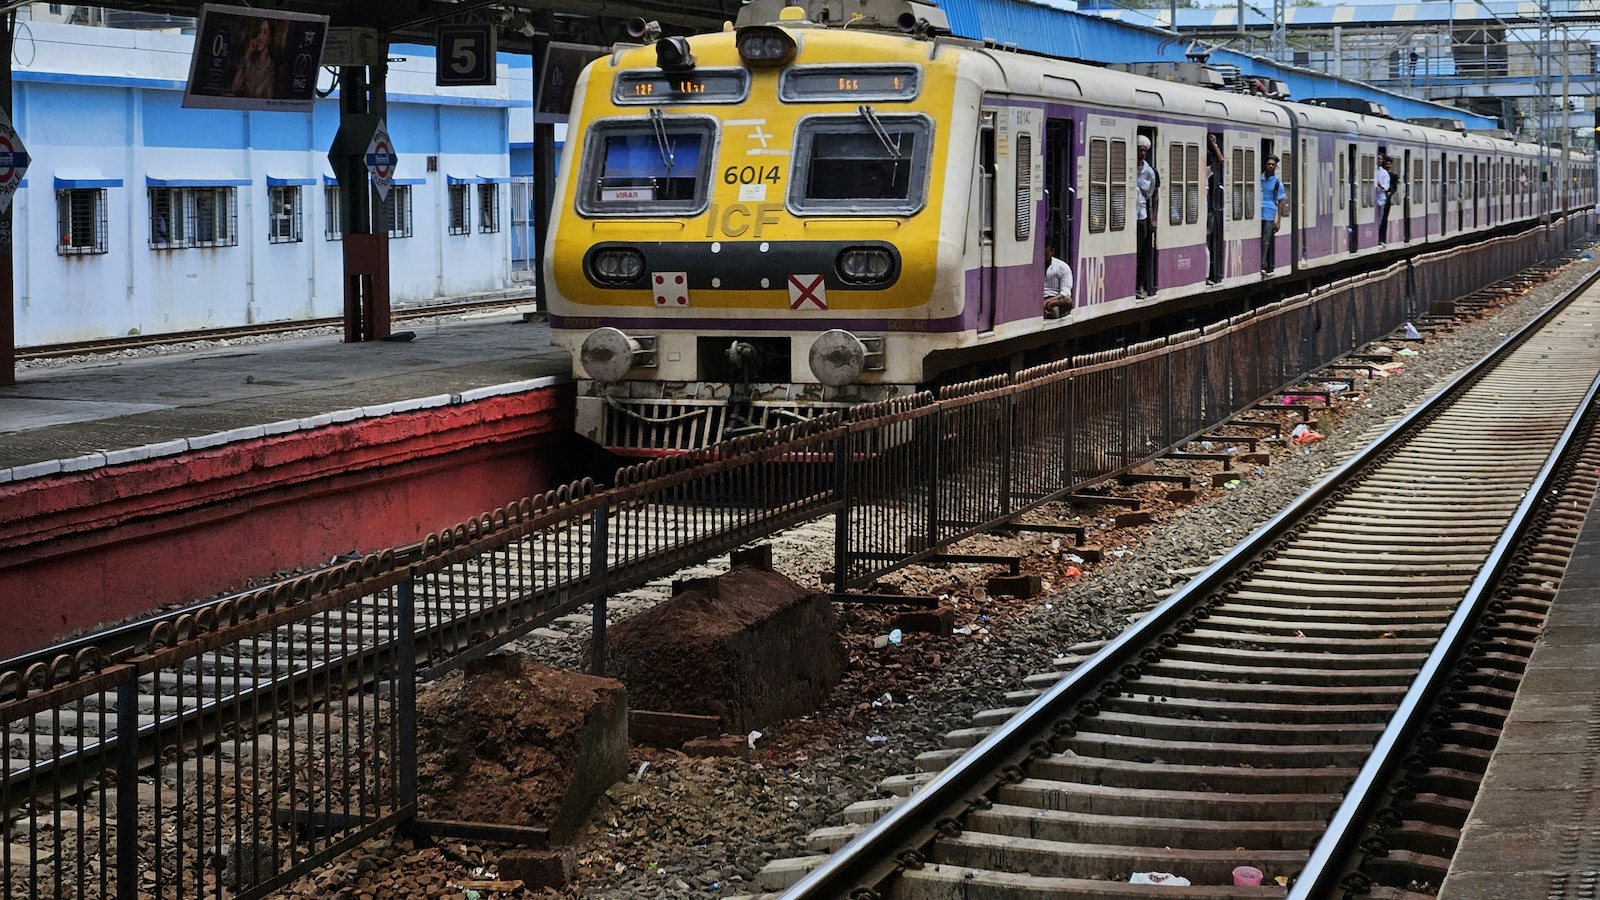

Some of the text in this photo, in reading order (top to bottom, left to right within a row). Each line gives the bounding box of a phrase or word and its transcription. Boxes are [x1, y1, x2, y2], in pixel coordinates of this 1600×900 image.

[450, 38, 477, 74] 5
[724, 165, 781, 185] 6014
[615, 191, 639, 199] VIRAR
[705, 203, 784, 238] ICF
